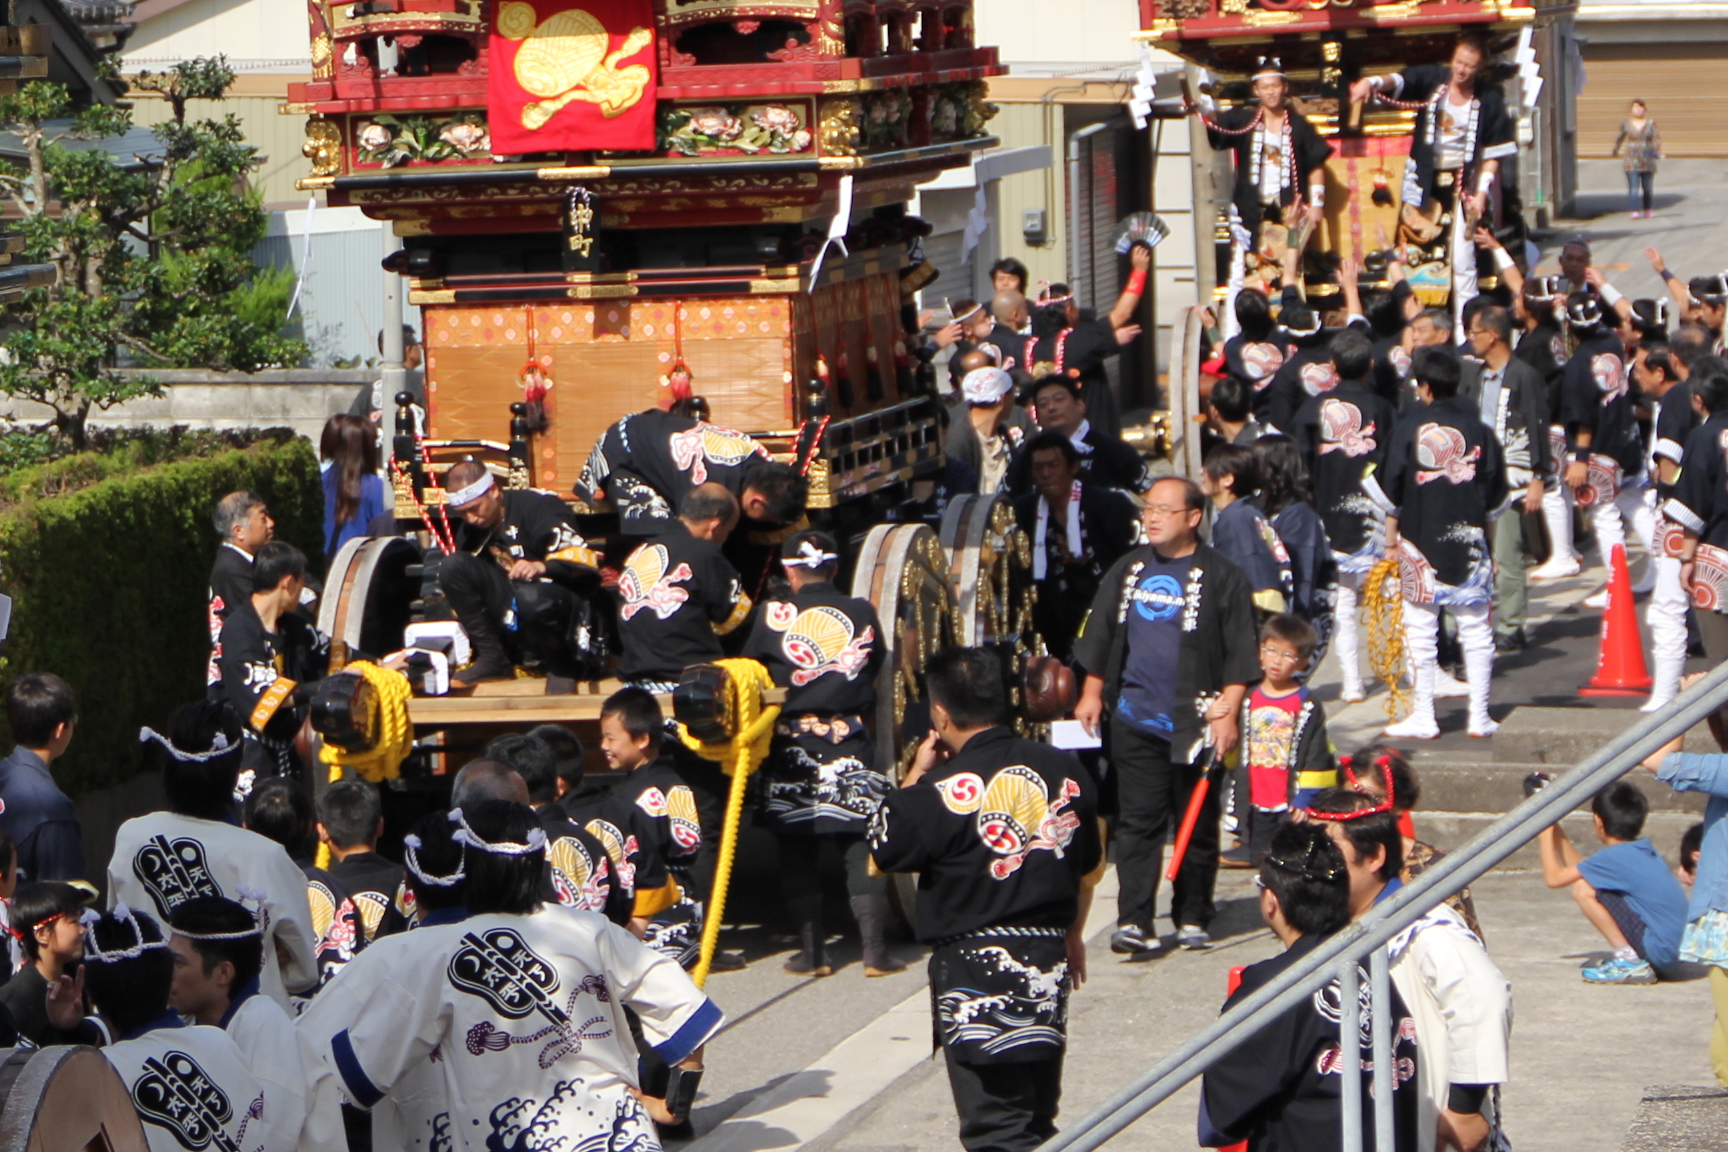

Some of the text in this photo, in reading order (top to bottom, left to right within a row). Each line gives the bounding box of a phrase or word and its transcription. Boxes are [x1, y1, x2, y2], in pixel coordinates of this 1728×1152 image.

[188, 866, 213, 897] 天下
[510, 949, 547, 982] 天下
[482, 966, 521, 1003] 太平
[190, 1075, 222, 1111] 天下
[165, 1095, 200, 1136] 太平
